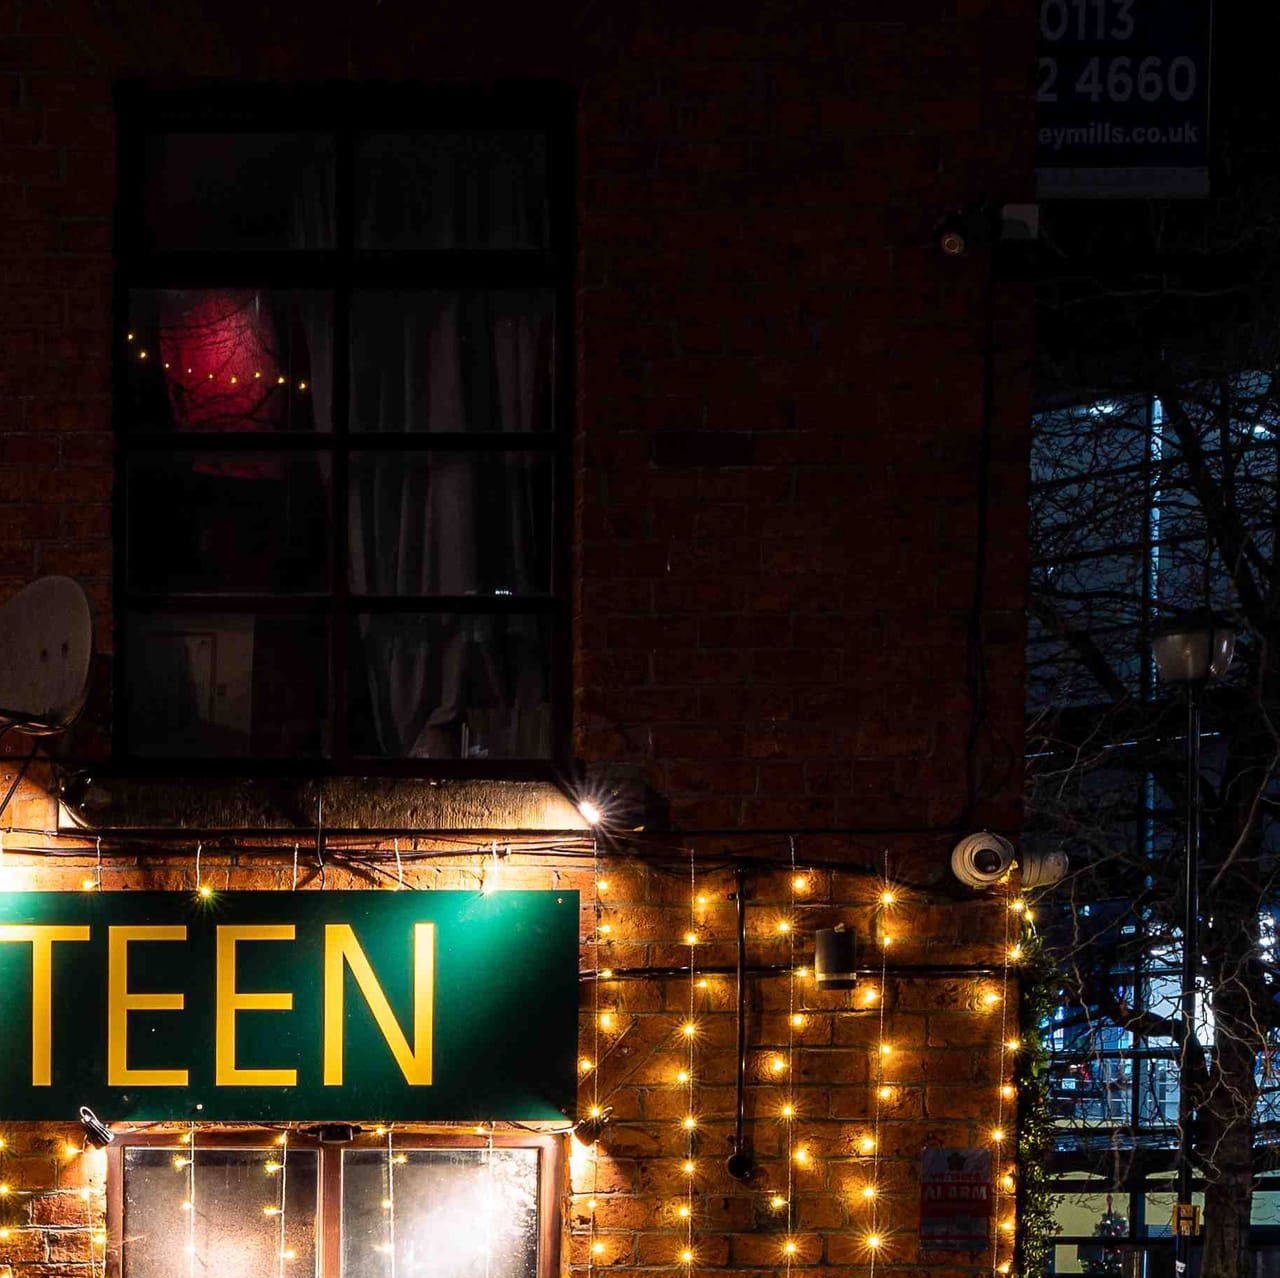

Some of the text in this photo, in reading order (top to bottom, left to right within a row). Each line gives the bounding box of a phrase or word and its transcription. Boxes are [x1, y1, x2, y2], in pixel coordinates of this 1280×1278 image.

[1039, 0, 1136, 41] 0113
[1075, 56, 1197, 103] 4660
[1038, 120, 1199, 150] eymills.co.uk
[925, 1185, 988, 1200] ALARM
